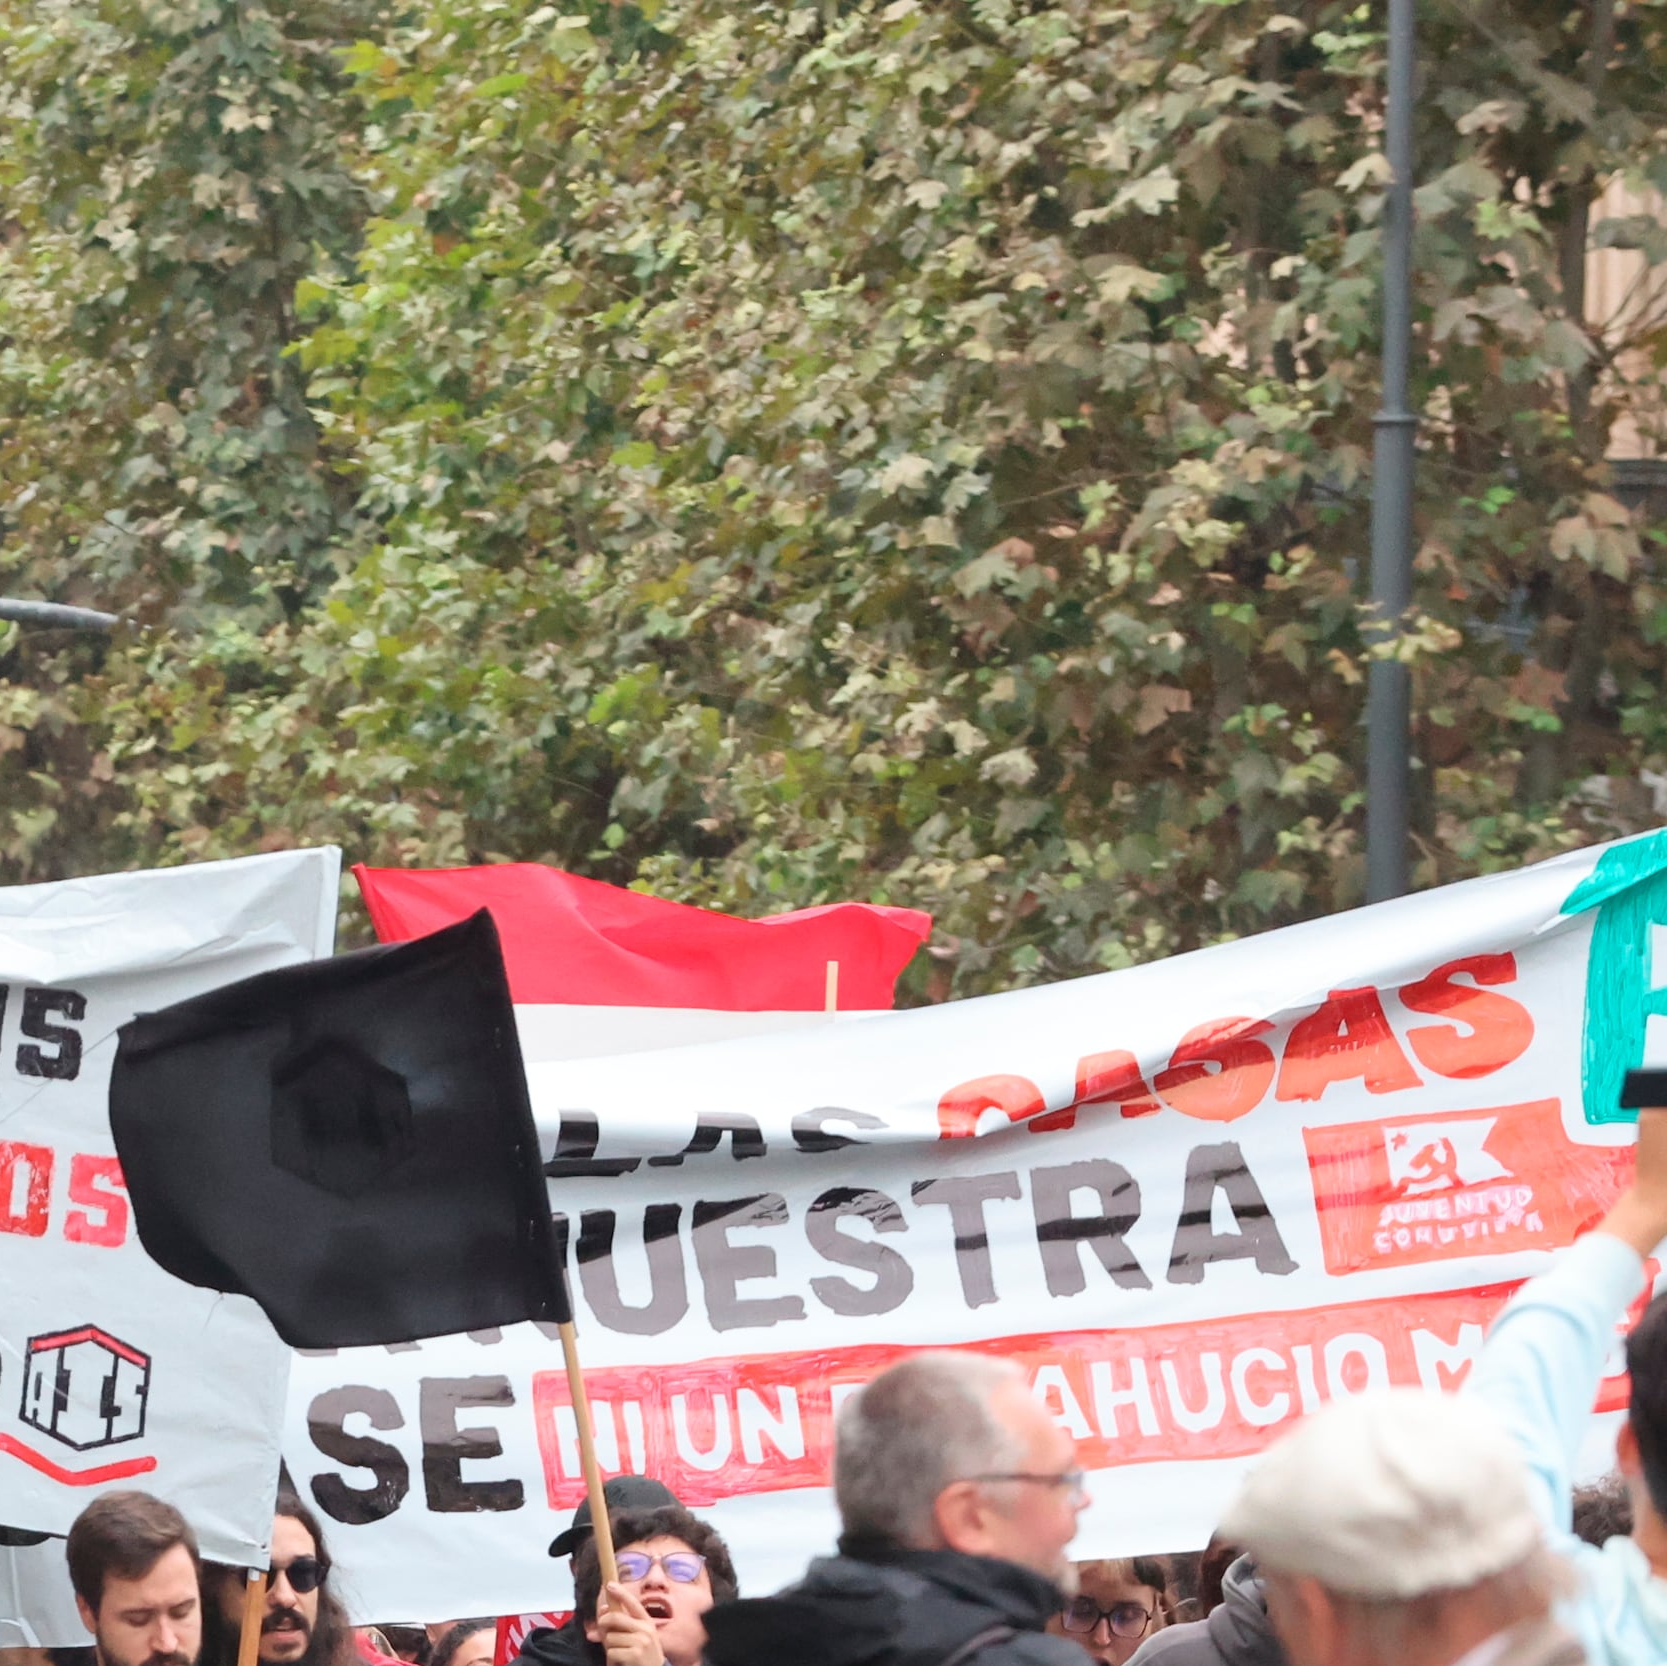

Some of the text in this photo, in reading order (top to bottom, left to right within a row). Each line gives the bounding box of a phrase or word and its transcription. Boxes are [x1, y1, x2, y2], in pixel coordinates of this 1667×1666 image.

[544, 1106, 890, 1177] LAS
[1378, 1185, 1533, 1227] JUVENTUD
[467, 1141, 1300, 1344] UESTRA
[279, 1375, 526, 1526] SE
[673, 1386, 806, 1472] UN
[927, 1332, 1390, 1440] AHUCIO
